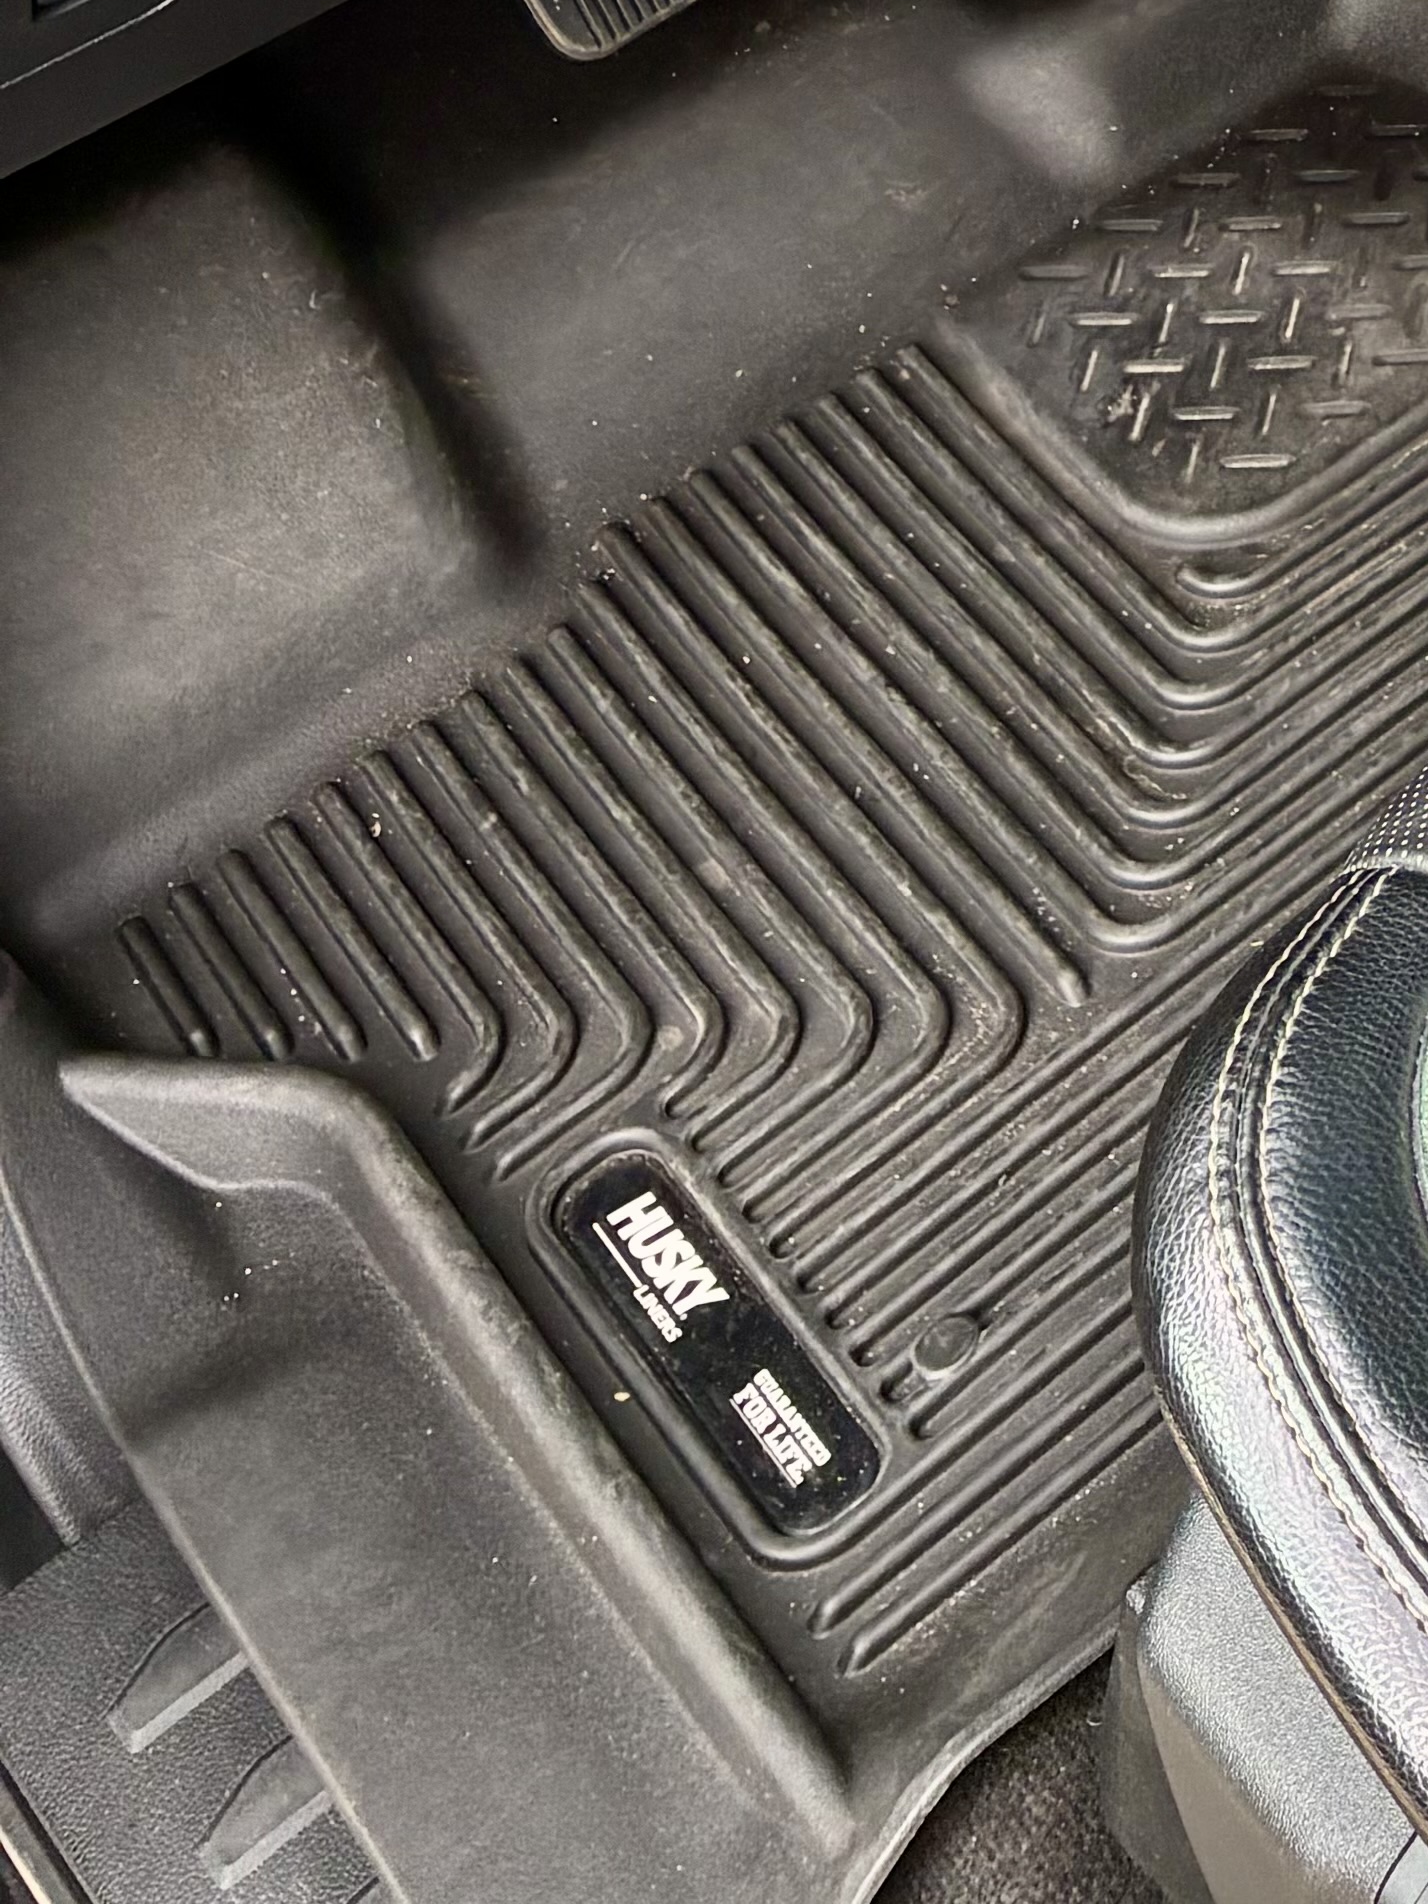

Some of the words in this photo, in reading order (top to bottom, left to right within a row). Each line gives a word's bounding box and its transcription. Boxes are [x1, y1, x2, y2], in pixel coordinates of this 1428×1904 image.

[606, 1191, 730, 1317] HUSKY
[632, 1284, 683, 1343] LINERS
[732, 1382, 777, 1434] FOR
[763, 1423, 813, 1482] LIFE
[753, 1368, 832, 1467] GUARANTEED
